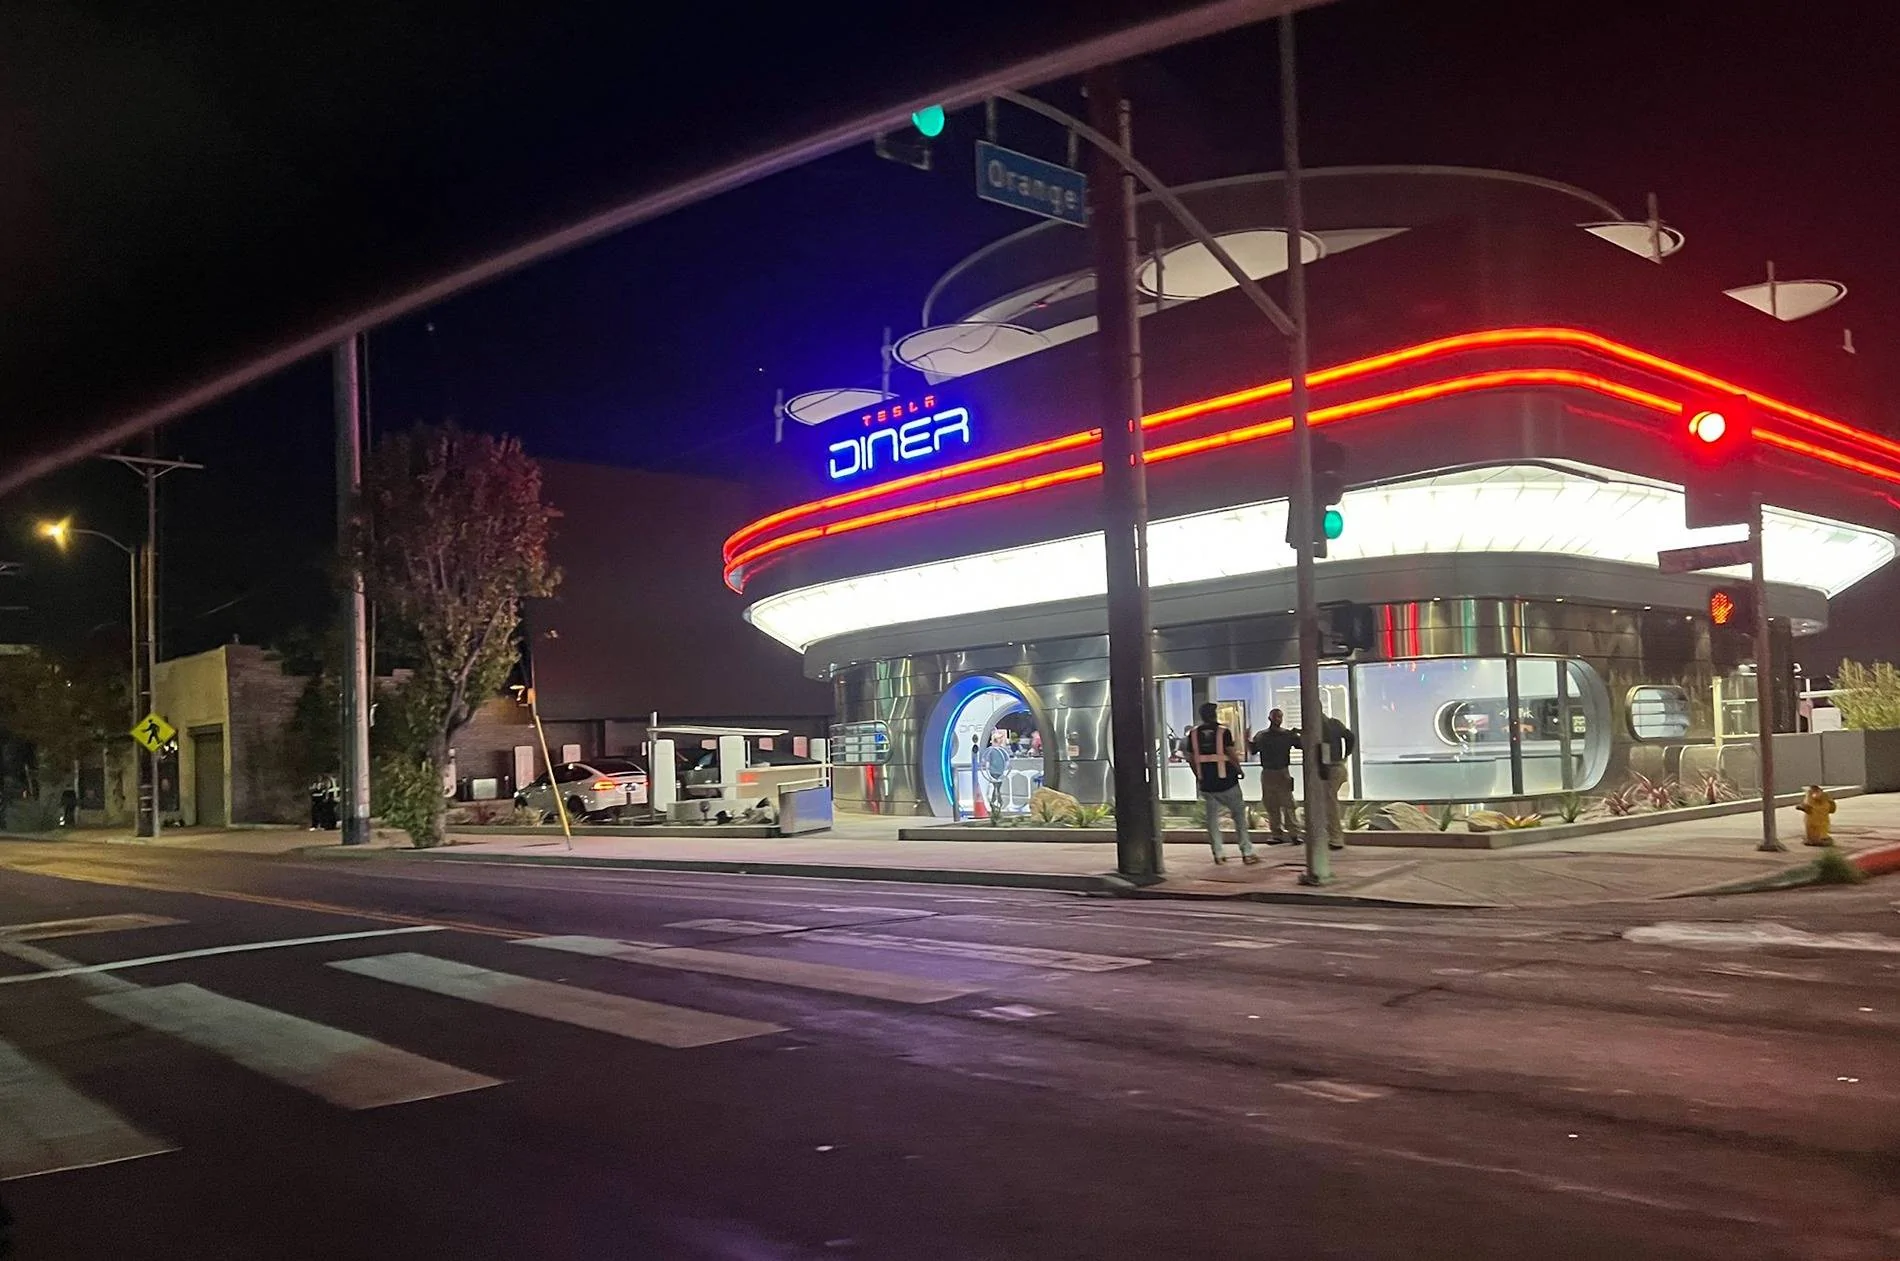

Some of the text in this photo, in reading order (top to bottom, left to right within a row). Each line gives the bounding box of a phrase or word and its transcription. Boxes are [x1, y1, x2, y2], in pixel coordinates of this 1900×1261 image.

[988, 159, 1077, 214] Orange
[862, 395, 935, 426] TESLA
[829, 407, 969, 478] DINER
